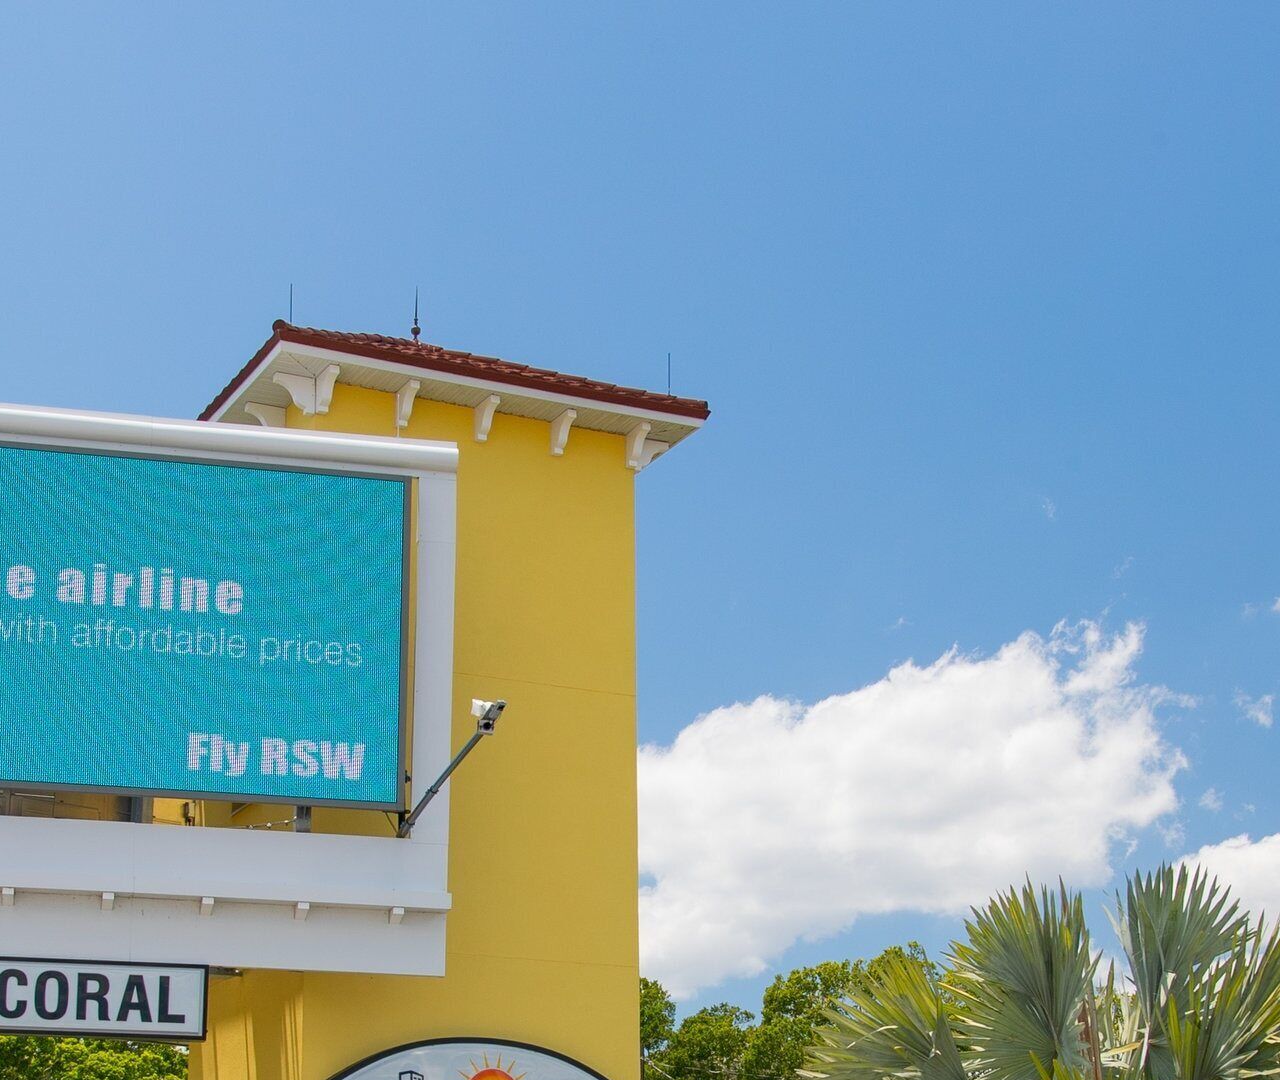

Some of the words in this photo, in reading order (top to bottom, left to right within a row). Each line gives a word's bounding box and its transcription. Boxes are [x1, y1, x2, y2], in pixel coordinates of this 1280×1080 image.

[56, 563, 244, 615] airline
[72, 618, 247, 658] affordable
[260, 633, 362, 667] prices
[188, 732, 249, 777] Fly
[260, 737, 365, 781] RSW
